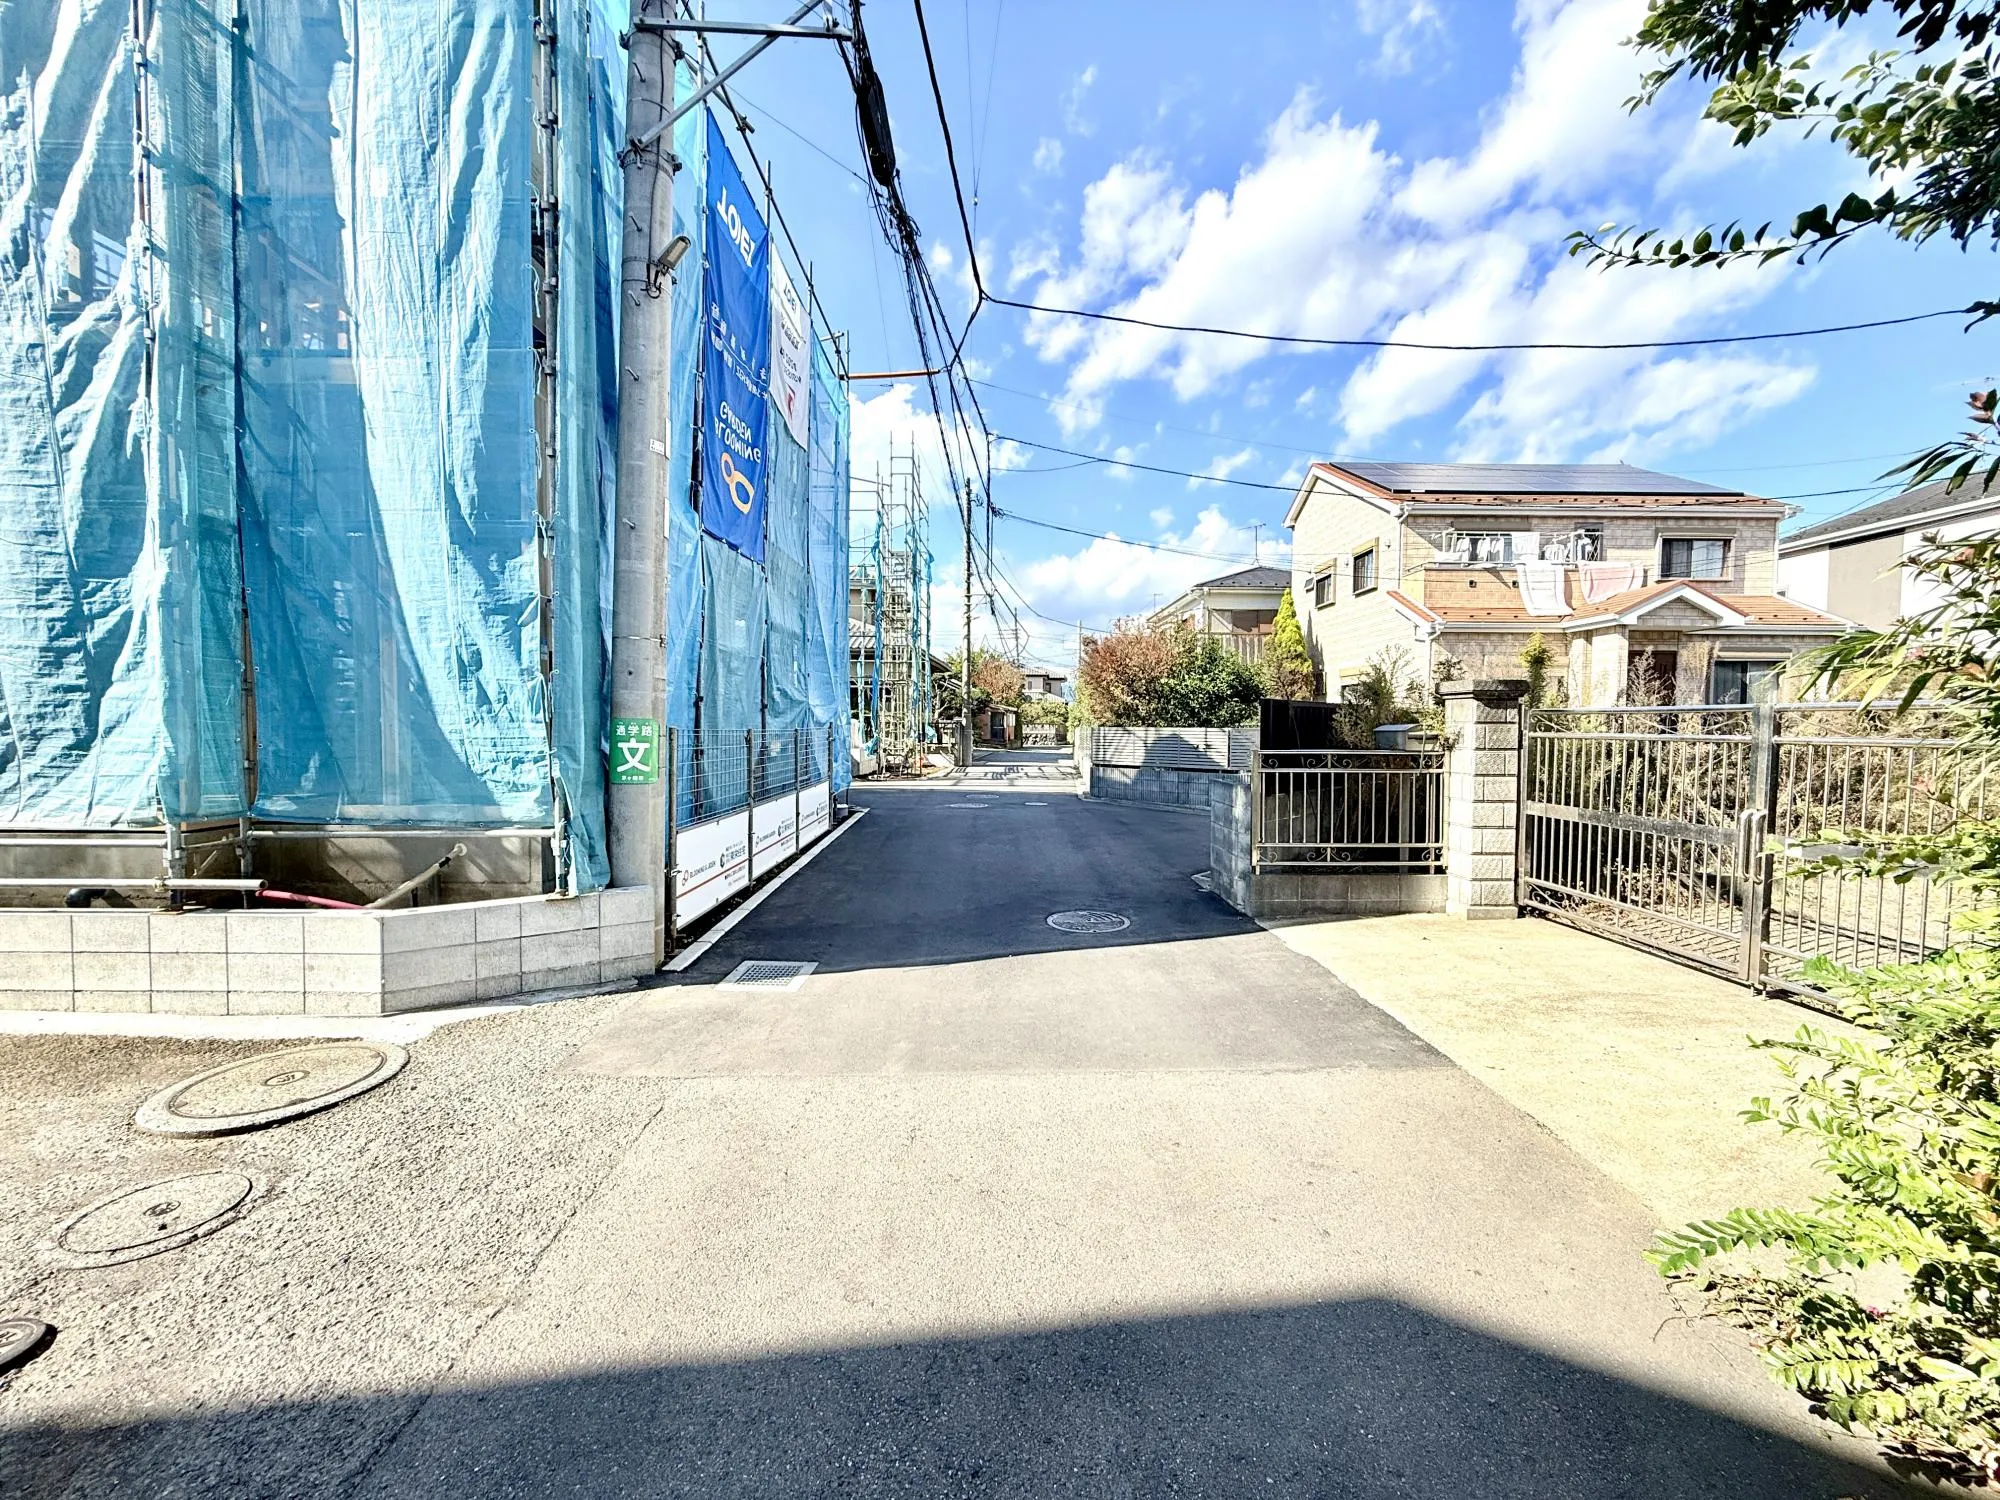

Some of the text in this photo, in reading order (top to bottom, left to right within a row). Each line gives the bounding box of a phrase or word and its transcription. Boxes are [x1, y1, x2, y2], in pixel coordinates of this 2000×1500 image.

[616, 724, 652, 736] 通学路
[617, 738, 651, 772] 文
